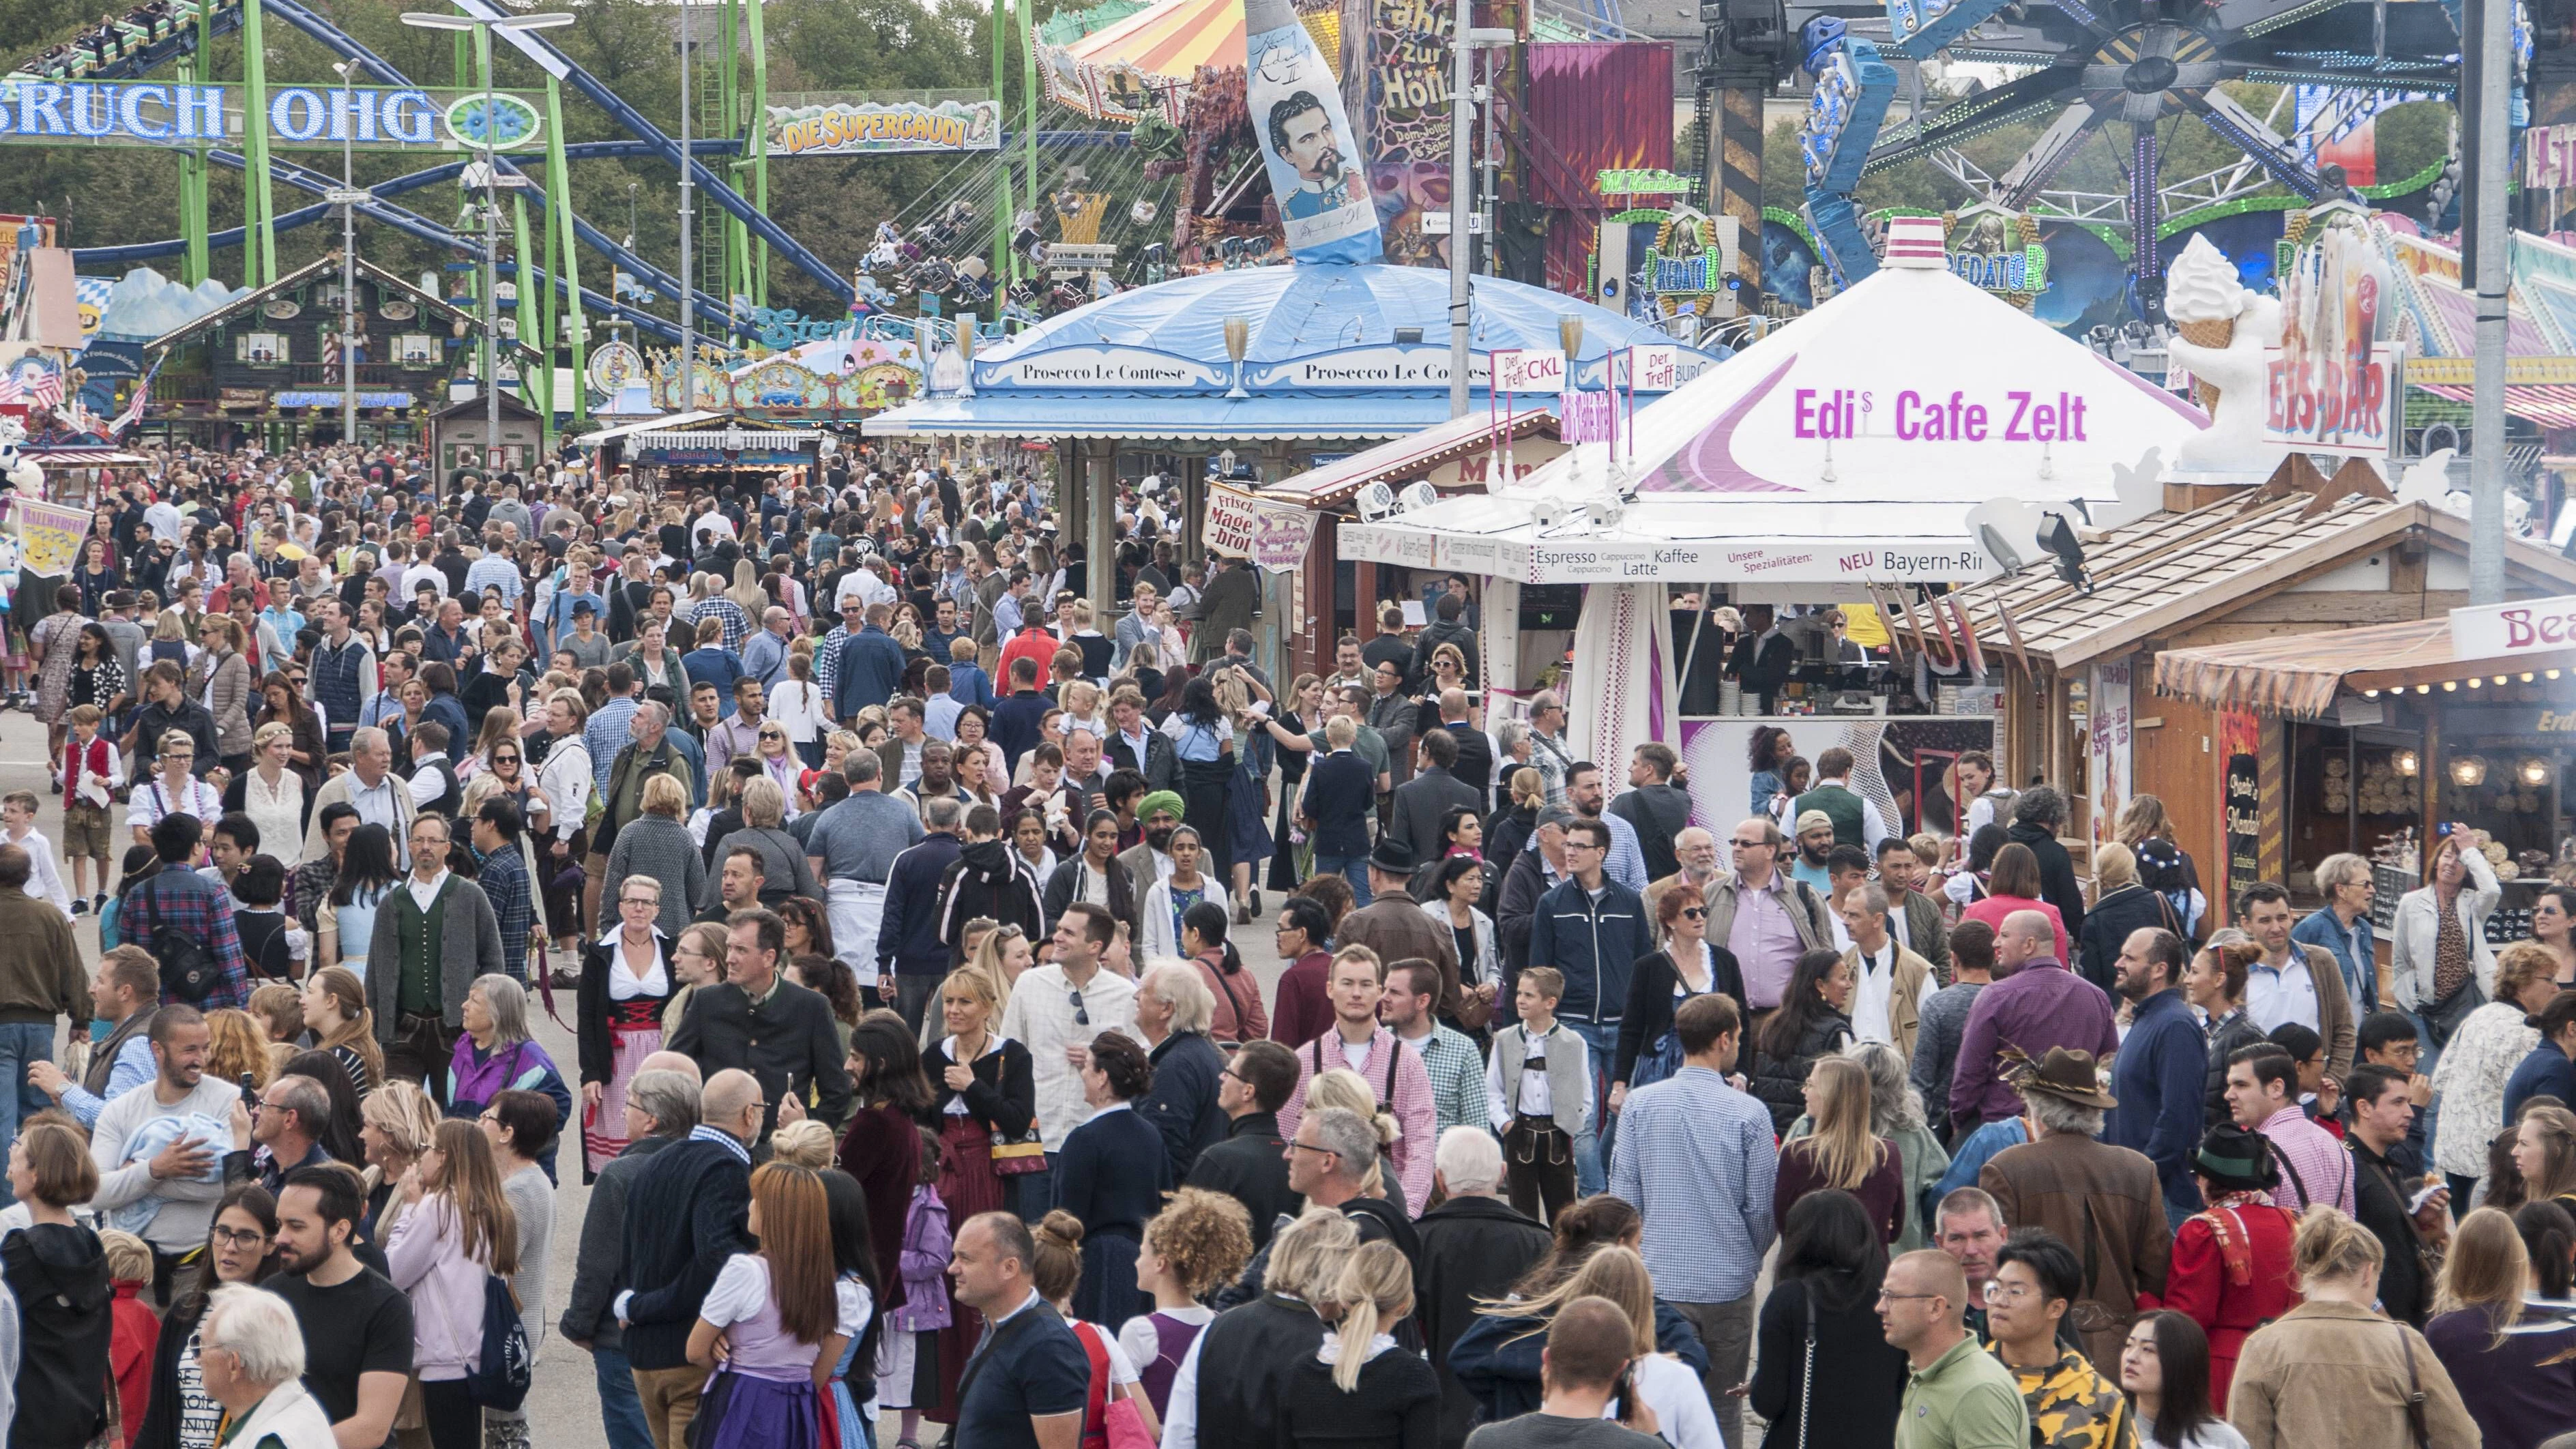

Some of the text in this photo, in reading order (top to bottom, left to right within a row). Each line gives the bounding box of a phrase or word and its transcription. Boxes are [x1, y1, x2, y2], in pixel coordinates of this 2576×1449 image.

[1402, 41, 1440, 63] zur
[1380, 65, 1450, 108] Höll
[0, 83, 437, 143] RUCH OHG
[786, 119, 823, 154] DIE
[1645, 246, 1721, 293] PREDATOR
[2148, 300, 2158, 310] 5
[1505, 355, 1519, 370] Der
[1650, 354, 1669, 368] Der
[1023, 364, 1186, 381] Prosecco Le Contesse
[1304, 364, 1388, 381] Prosecco
[1394, 364, 1417, 381] Le
[1645, 364, 1674, 387] Treff
[1896, 390, 1988, 442] Cafe
[2004, 390, 2087, 442] Zelt
[1536, 550, 1596, 567] Espresso
[1600, 552, 1645, 561] Cappuccino
[1654, 548, 1698, 563] Kaffee
[1727, 550, 1764, 564] Unsere
[1742, 553, 1813, 574] Spezialitäten:
[1839, 550, 1875, 572] NEU
[1567, 561, 1658, 575] Cappuccino Latte
